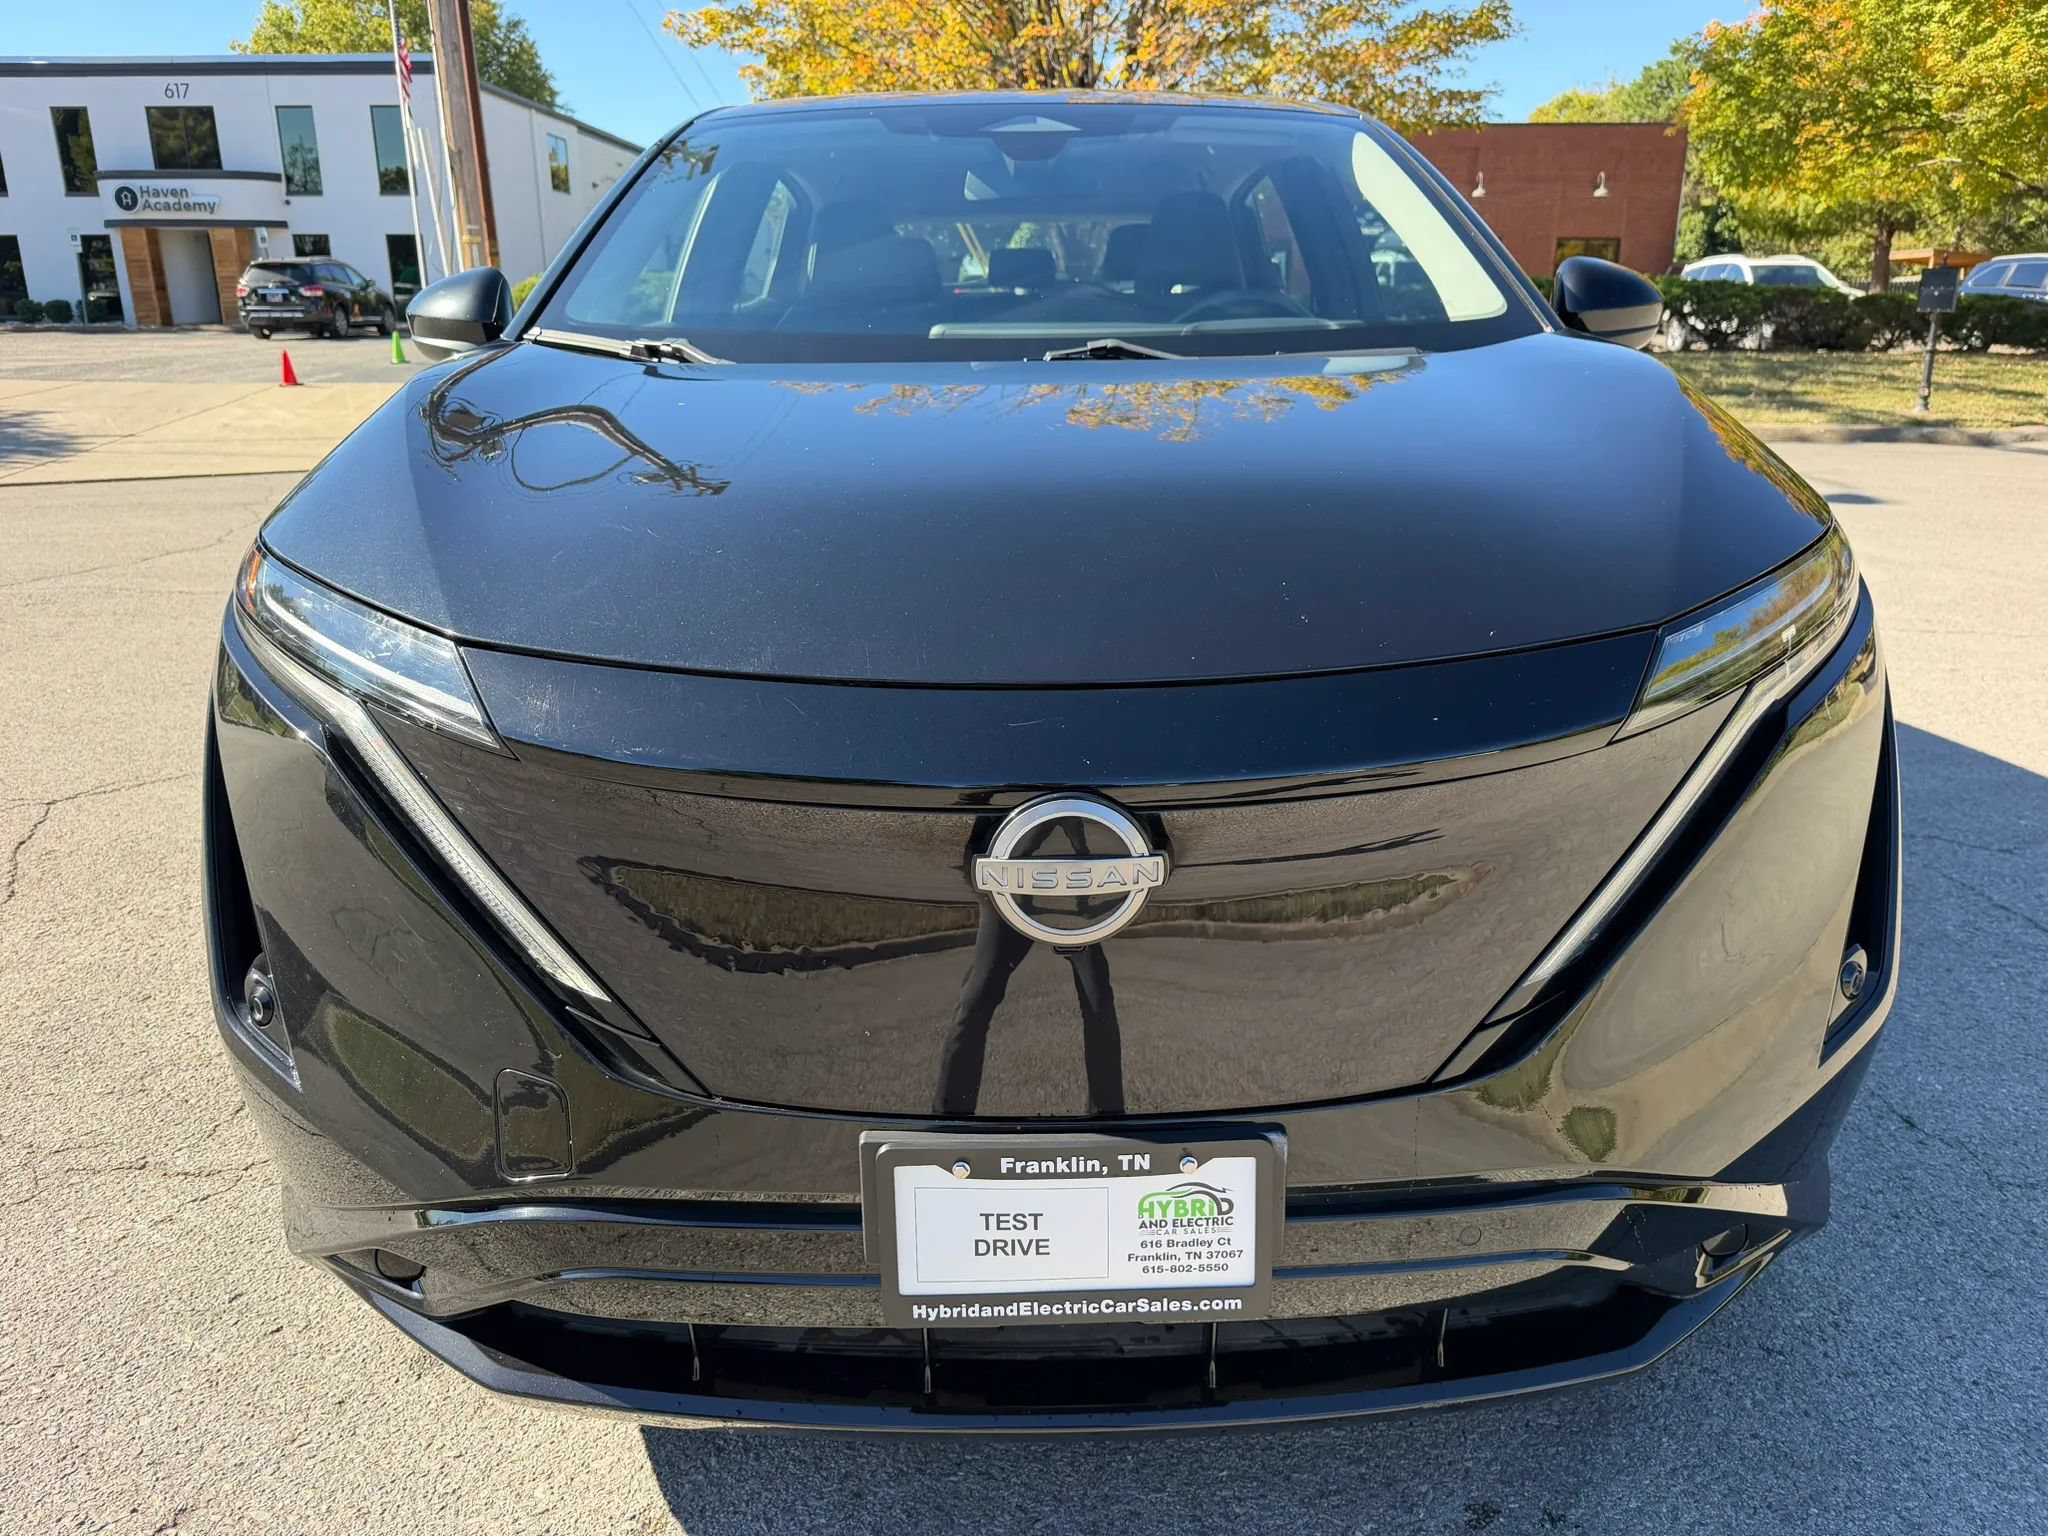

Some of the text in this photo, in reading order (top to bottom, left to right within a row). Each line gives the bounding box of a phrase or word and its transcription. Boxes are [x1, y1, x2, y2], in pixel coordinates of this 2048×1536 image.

[164, 83, 190, 99] 617
[140, 185, 189, 198] Haven
[142, 199, 217, 214] Academy
[981, 861, 1159, 889] NISSAN
[1000, 1153, 1151, 1175] Franklin, TN
[979, 1213, 1044, 1231] TEST
[1138, 1216, 1234, 1230] AND ELECTRIC
[1156, 1227, 1217, 1236] CAR SALES
[974, 1238, 1051, 1257] DRIVE
[1140, 1237, 1232, 1249] 616 Bradley Ct
[1127, 1249, 1244, 1262] Franklin, TN 37067
[1142, 1263, 1229, 1274] 615-802-5550
[912, 1298, 1243, 1321] HybridandElectricCarSales.com
